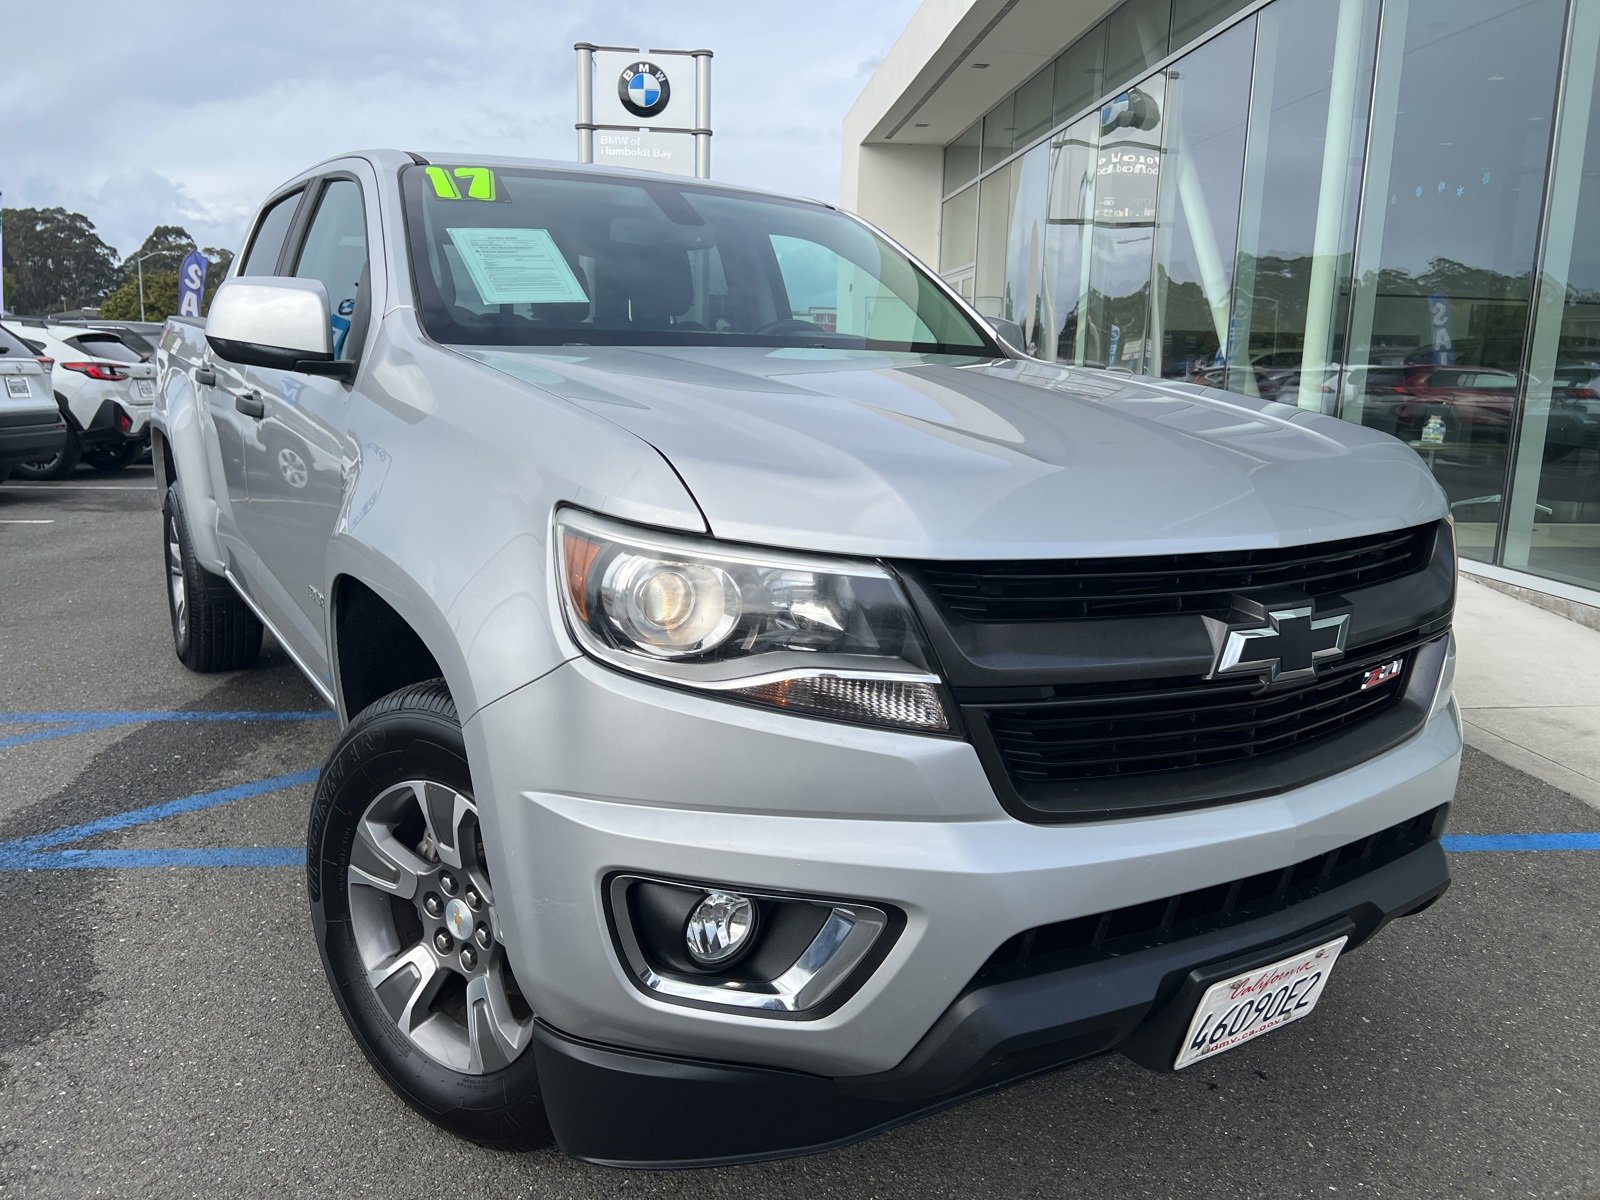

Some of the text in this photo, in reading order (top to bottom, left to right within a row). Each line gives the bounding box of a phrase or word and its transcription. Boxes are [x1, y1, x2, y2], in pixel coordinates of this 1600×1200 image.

[623, 63, 667, 82] BMW
[600, 135, 641, 146] BMW of
[600, 146, 673, 161] Humboldt Bay
[425, 166, 496, 201] 17
[181, 263, 202, 318] SA
[1360, 658, 1403, 690] Z71
[1230, 960, 1315, 1000] California
[1190, 971, 1322, 1051] 46090E2
[1210, 1018, 1281, 1052] dmv.ca.gov
